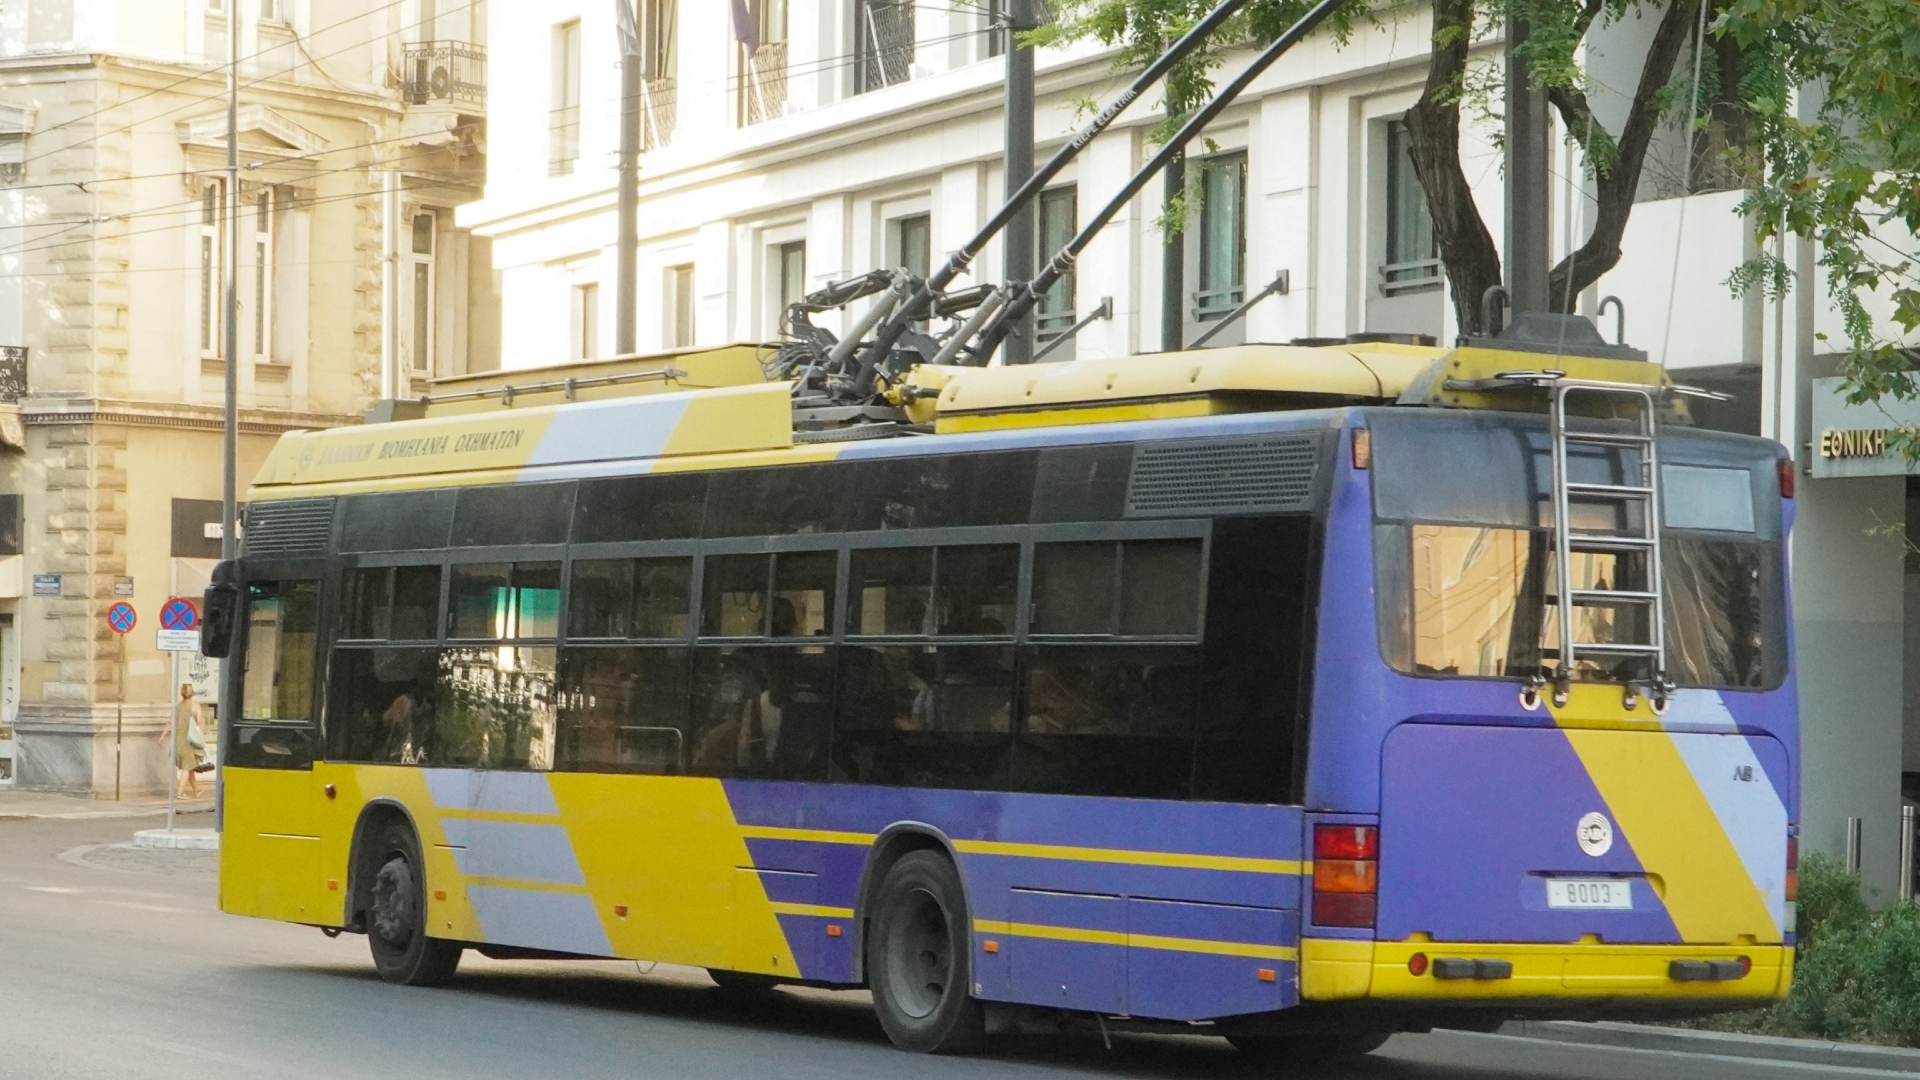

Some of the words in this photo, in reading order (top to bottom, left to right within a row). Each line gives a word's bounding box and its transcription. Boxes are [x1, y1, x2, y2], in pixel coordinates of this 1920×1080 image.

[1071, 124, 1099, 150] KIEPE
[1095, 88, 1138, 127] ELEKTRIK
[378, 436, 449, 460] ΒΙΟΜΗΧΑΝΙΑ
[454, 429, 525, 453] ΟΧΗΜΑΤΩΝ
[1820, 429, 1887, 458] ΕΘΝΙΚΗ
[1566, 883, 1611, 903] 8003
